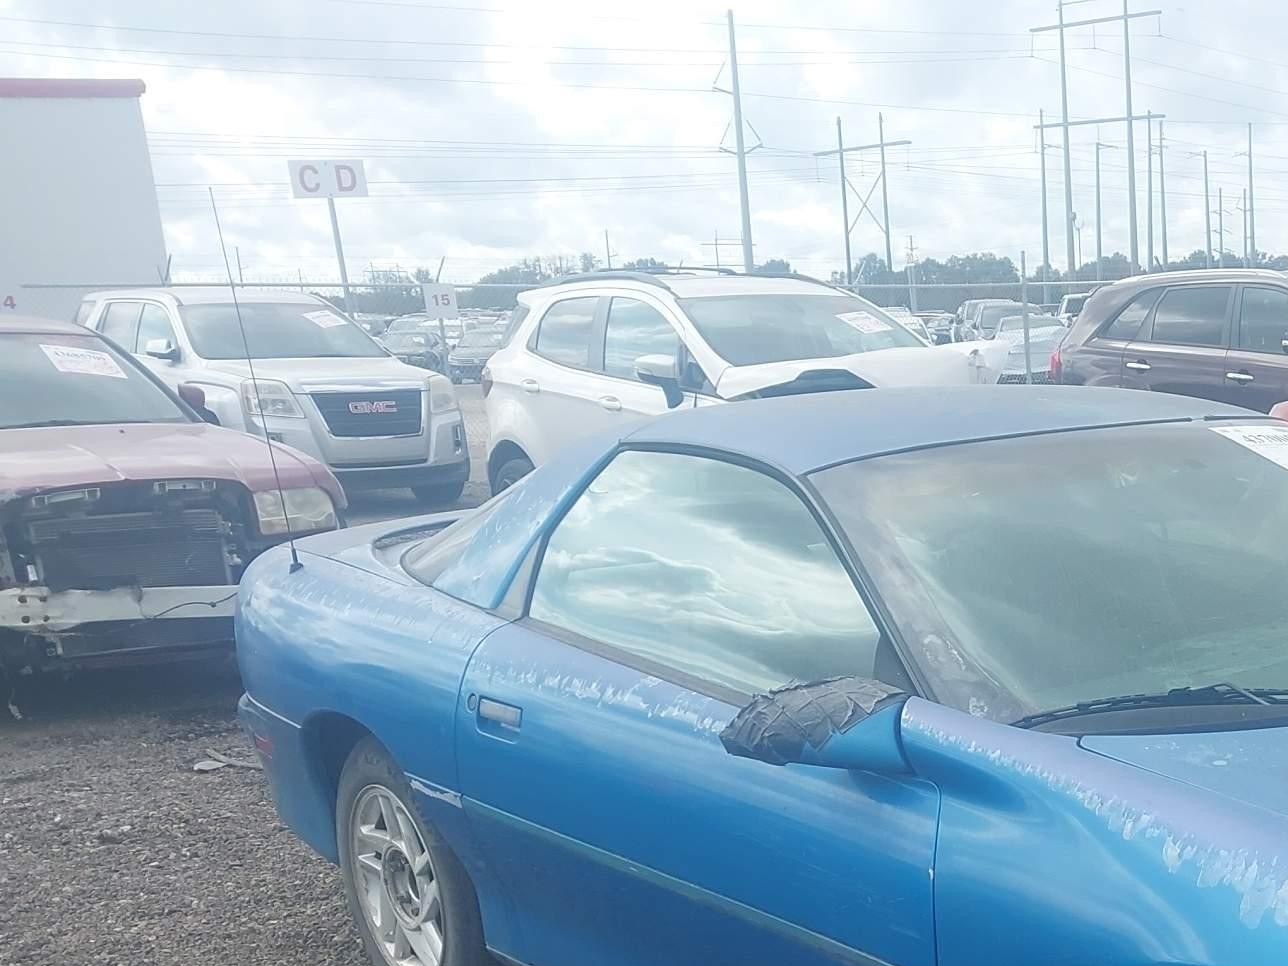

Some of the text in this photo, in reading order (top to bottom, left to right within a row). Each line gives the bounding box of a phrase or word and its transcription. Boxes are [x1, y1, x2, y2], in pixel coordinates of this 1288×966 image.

[299, 164, 357, 193] C D
[432, 294, 451, 306] 15
[348, 400, 399, 414] GMC
